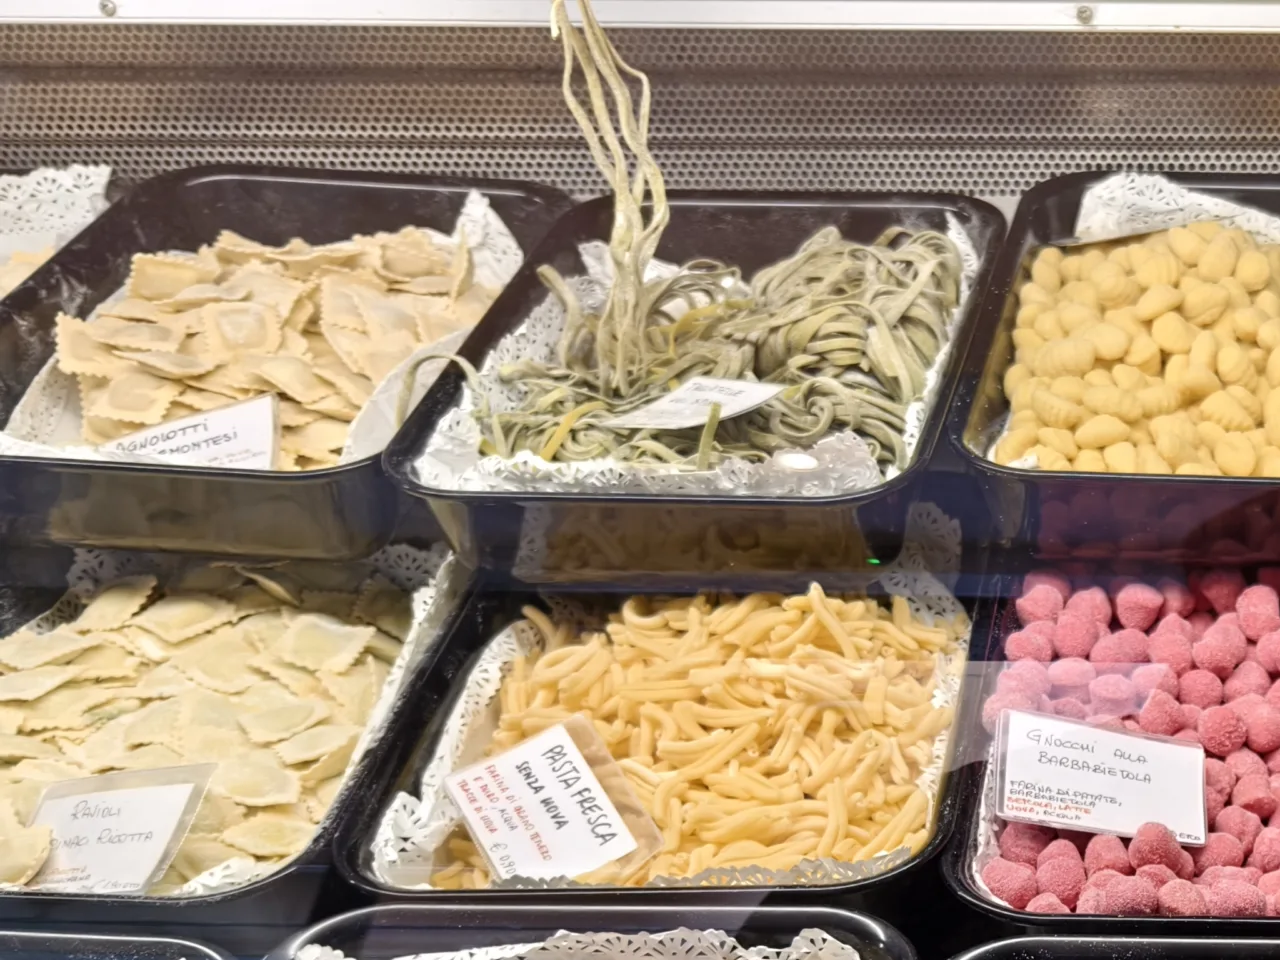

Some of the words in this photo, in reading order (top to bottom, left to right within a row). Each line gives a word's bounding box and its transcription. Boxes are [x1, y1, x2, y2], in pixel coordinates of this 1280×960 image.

[515, 761, 545, 795] SENZA
[540, 797, 570, 831] UOVA
[541, 744, 582, 790] PASTA
[571, 787, 618, 847] FRESCA
